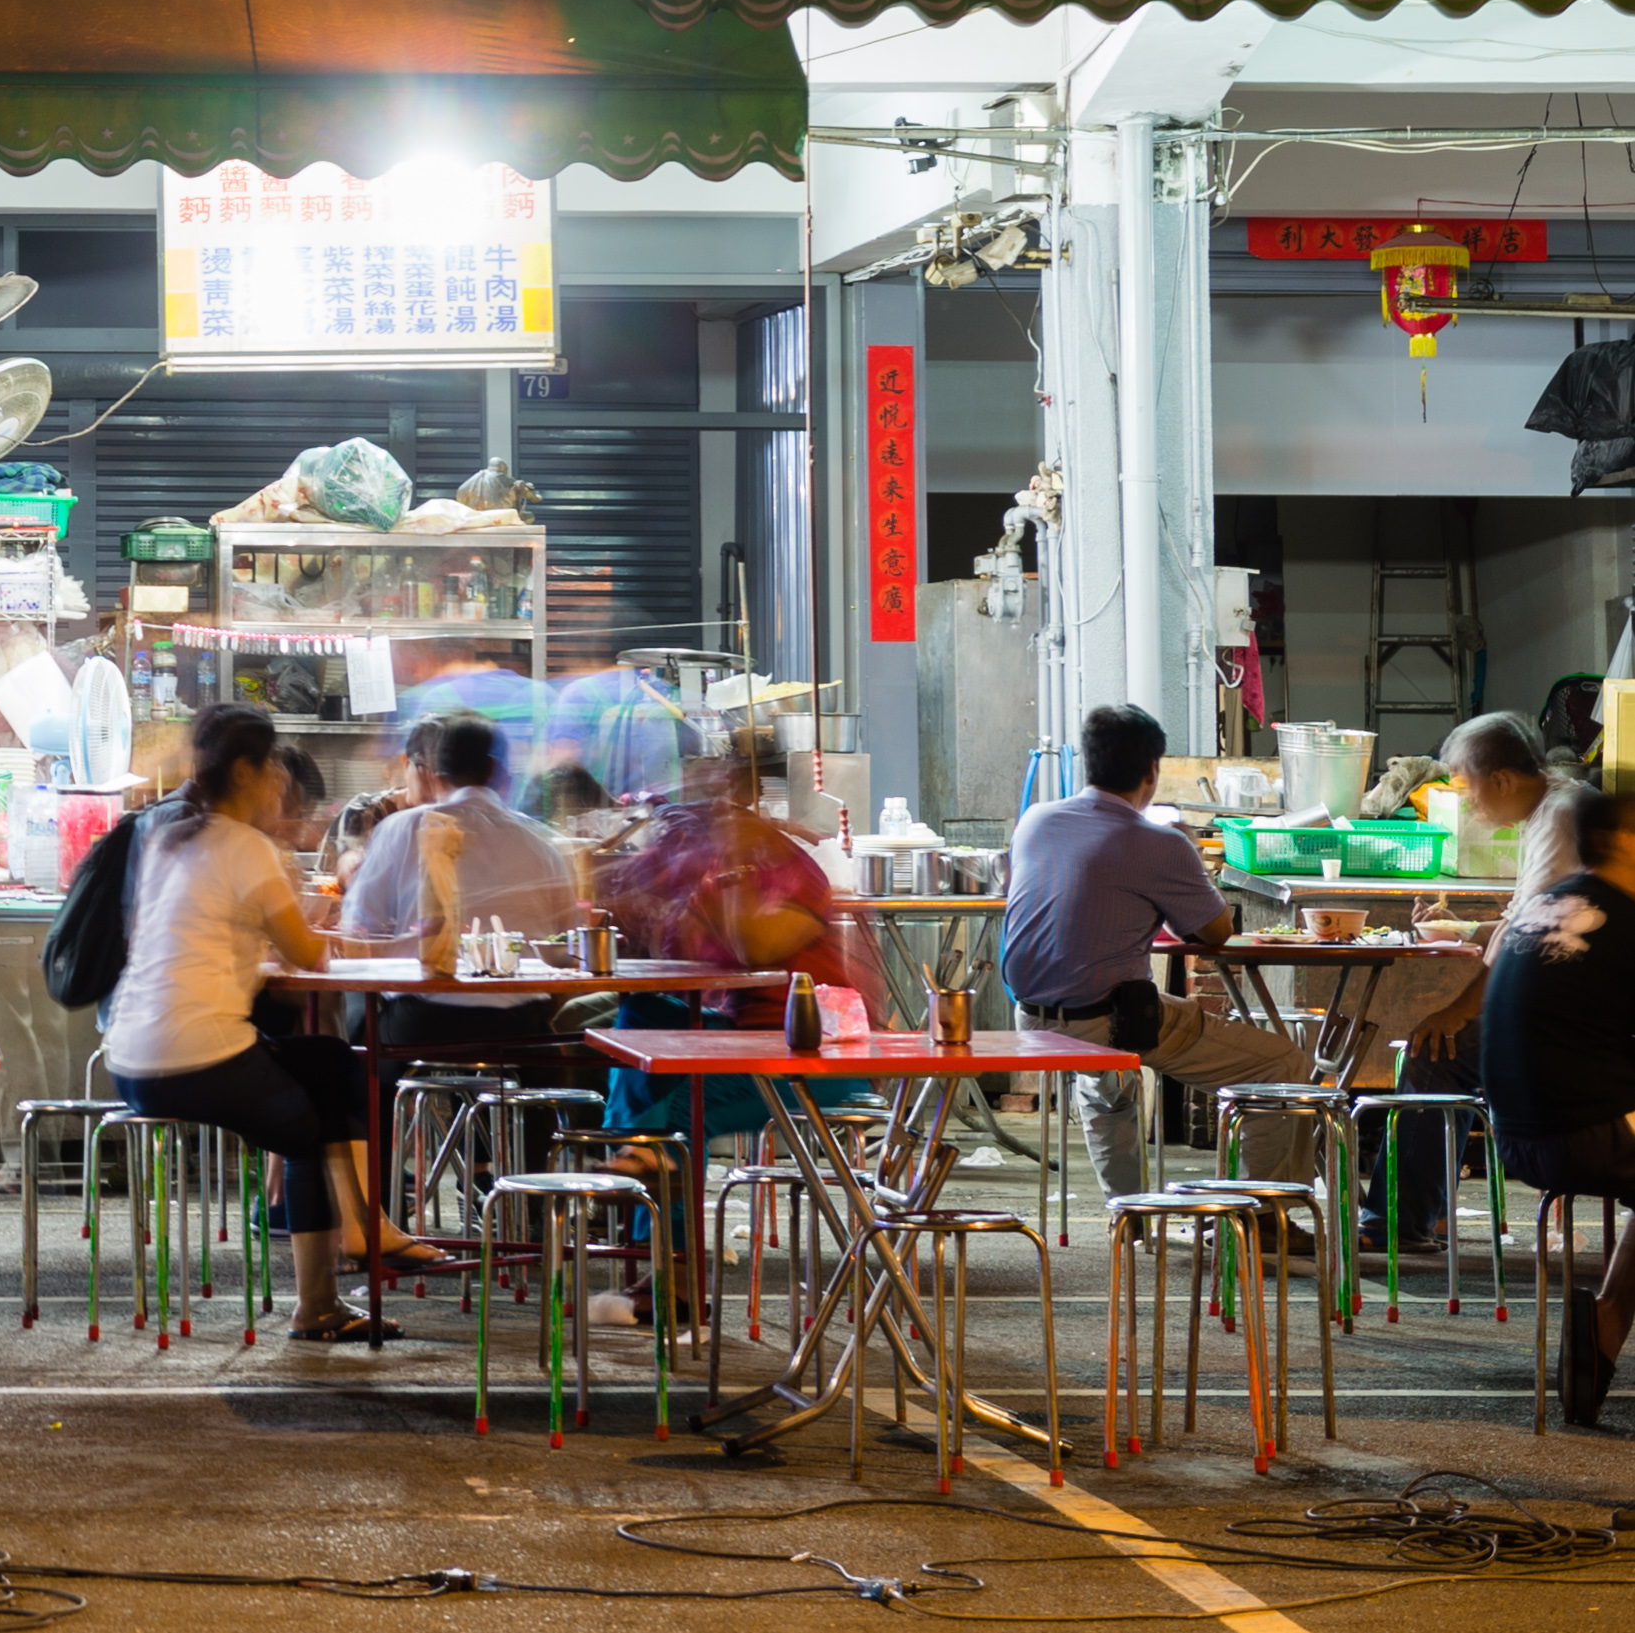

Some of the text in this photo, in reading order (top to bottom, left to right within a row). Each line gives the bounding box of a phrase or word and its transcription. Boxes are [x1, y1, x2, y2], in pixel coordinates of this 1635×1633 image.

[323, 244, 357, 335] 紫菜湯
[444, 244, 478, 334] 餛飩湯
[484, 243, 518, 333] 牛肉湯
[523, 375, 550, 398] 79
